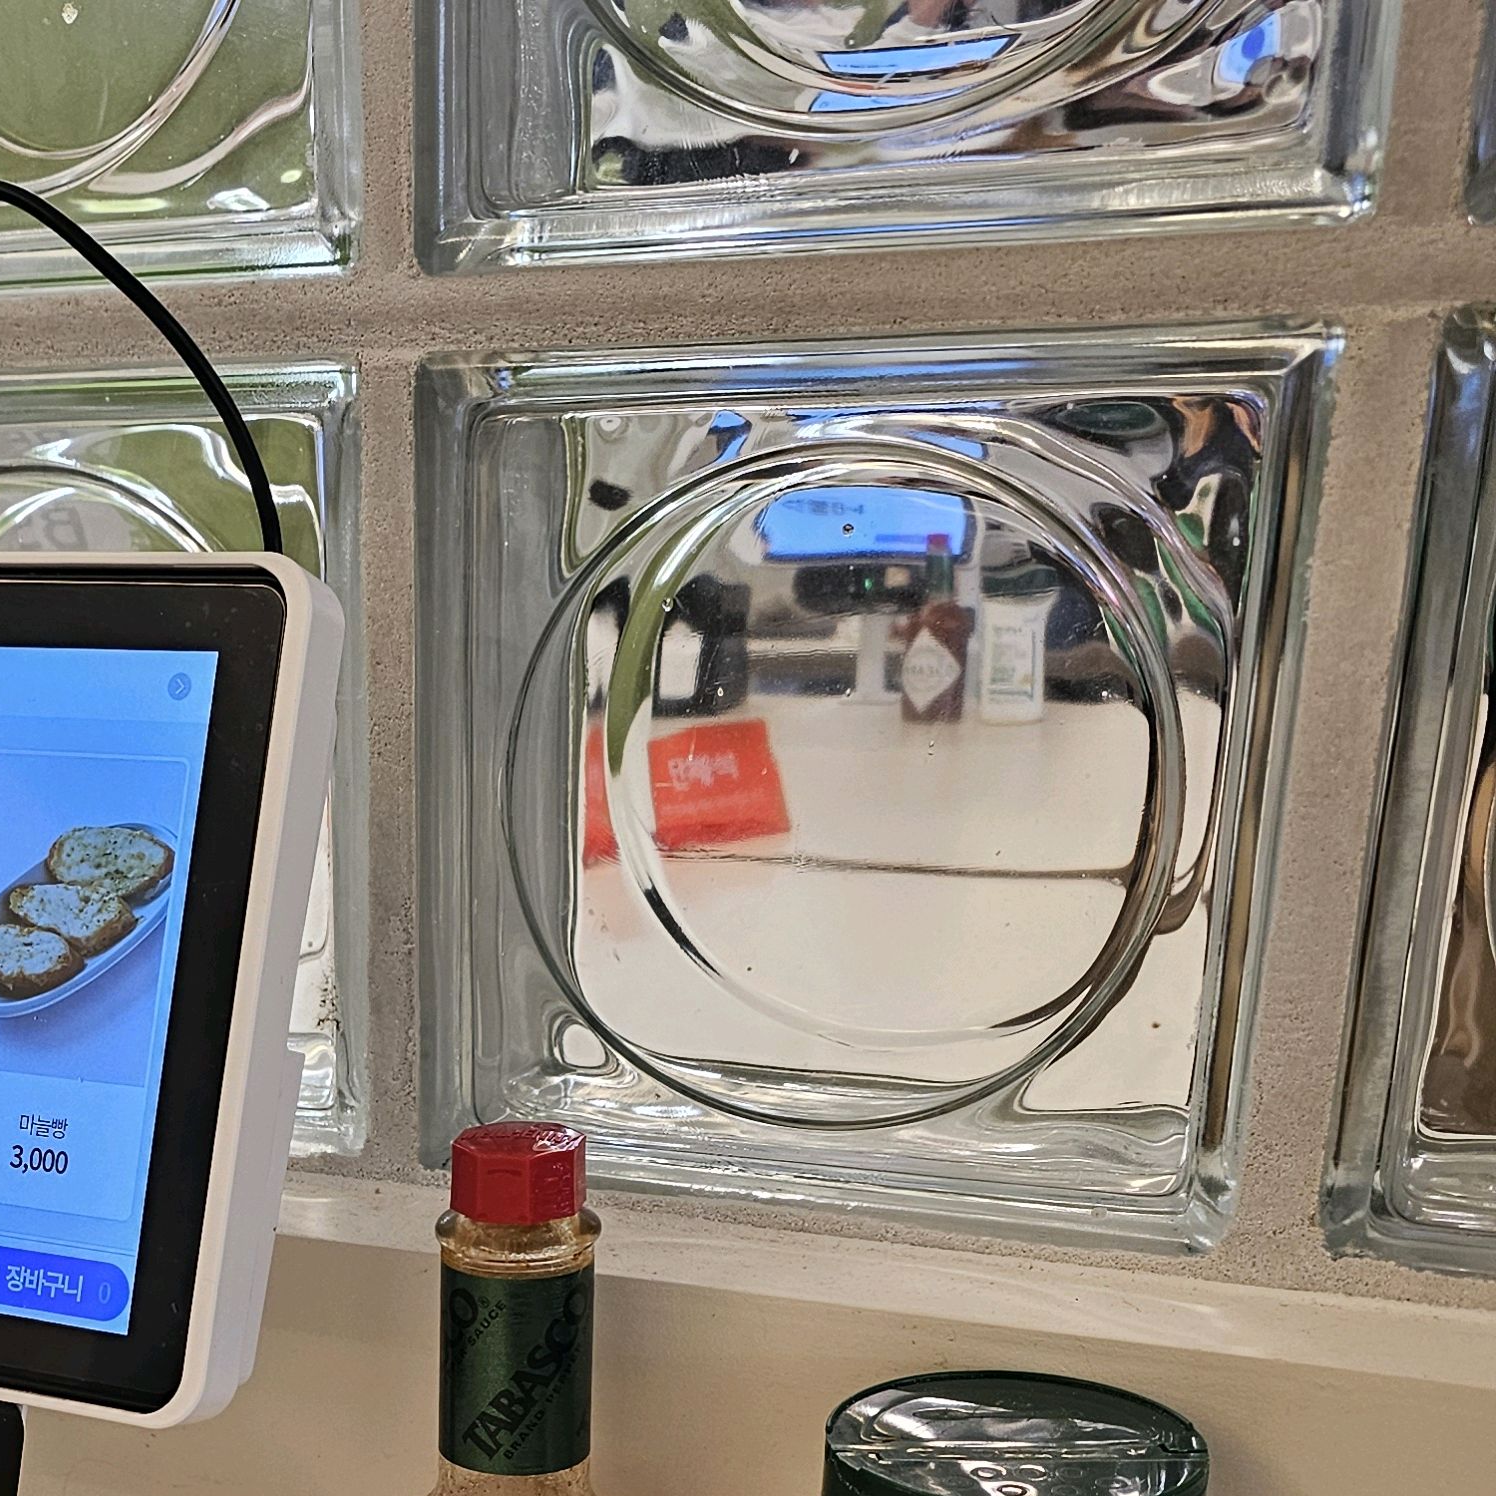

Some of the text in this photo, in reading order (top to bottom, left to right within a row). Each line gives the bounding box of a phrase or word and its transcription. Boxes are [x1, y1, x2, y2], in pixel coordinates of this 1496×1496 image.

[19, 1113, 69, 1140] 마늘빵
[9, 1144, 69, 1175] 3,000
[5, 1265, 84, 1302] 장바구니
[468, 1300, 507, 1346] SAUCE
[462, 1283, 587, 1461] TABASCO
[502, 1408, 546, 1460] BRAND
